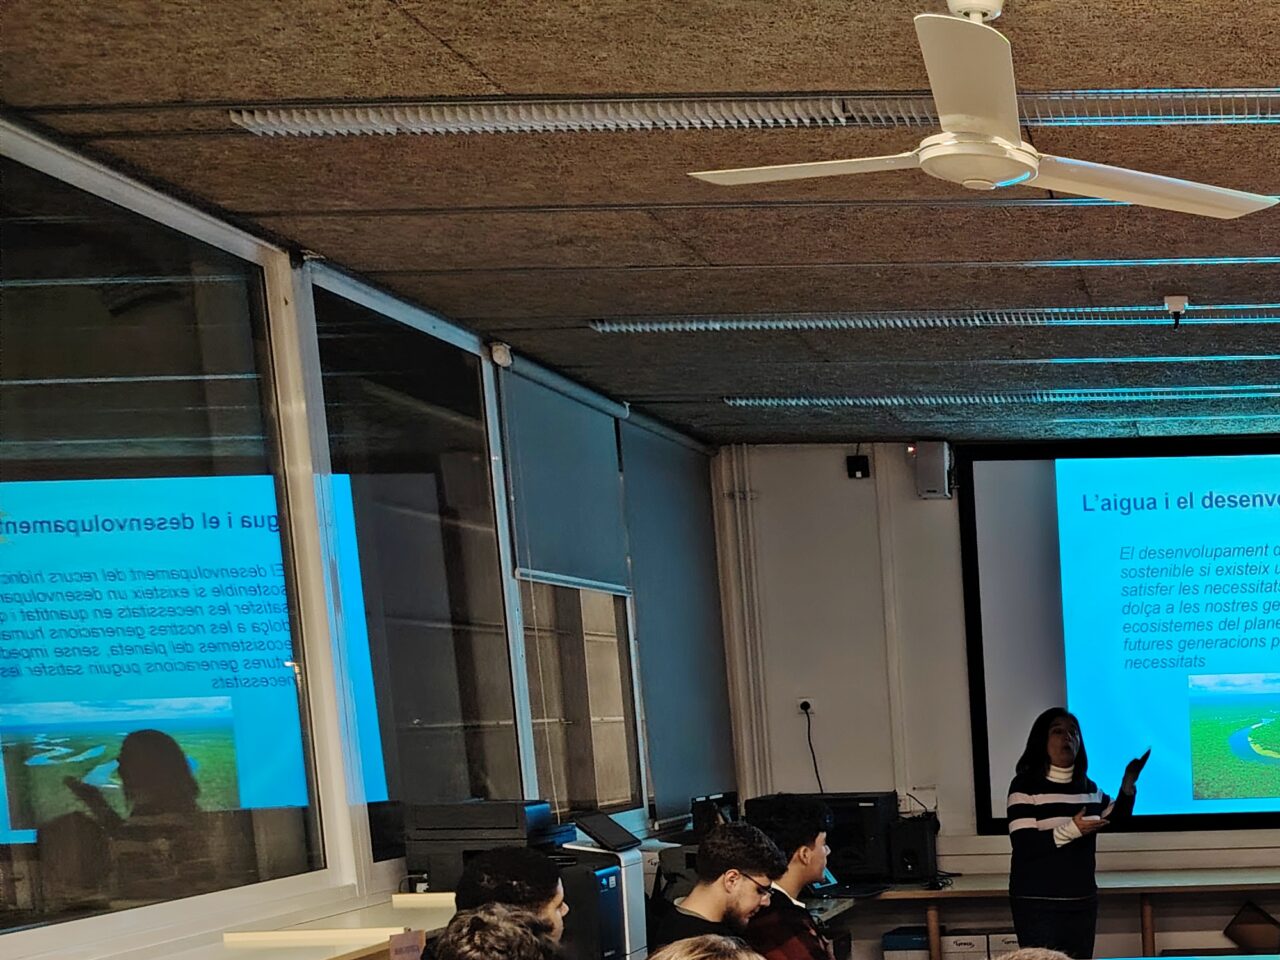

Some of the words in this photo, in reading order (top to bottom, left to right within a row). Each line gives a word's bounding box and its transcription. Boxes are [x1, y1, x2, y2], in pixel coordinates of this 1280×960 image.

[1082, 490, 1157, 516] L'aigua
[1164, 493, 1169, 510] i
[1176, 490, 1195, 510] el
[1119, 546, 1136, 560] El
[1139, 543, 1269, 562] desenvolupament
[1120, 563, 1194, 579] sostenible
[1197, 562, 1210, 577] si
[1214, 561, 1270, 577] existeix
[1121, 581, 1176, 597] satisfer
[1179, 580, 1199, 595] les
[1122, 599, 1162, 617] dolça
[1165, 602, 1175, 614] a
[1179, 599, 1200, 613] les
[1204, 597, 1258, 612] nostres
[1122, 617, 1214, 634] ecosistemes
[1217, 616, 1240, 631] del
[1123, 636, 1174, 652] futures
[1177, 635, 1266, 653] generacions
[1124, 653, 1206, 670] necessitats
